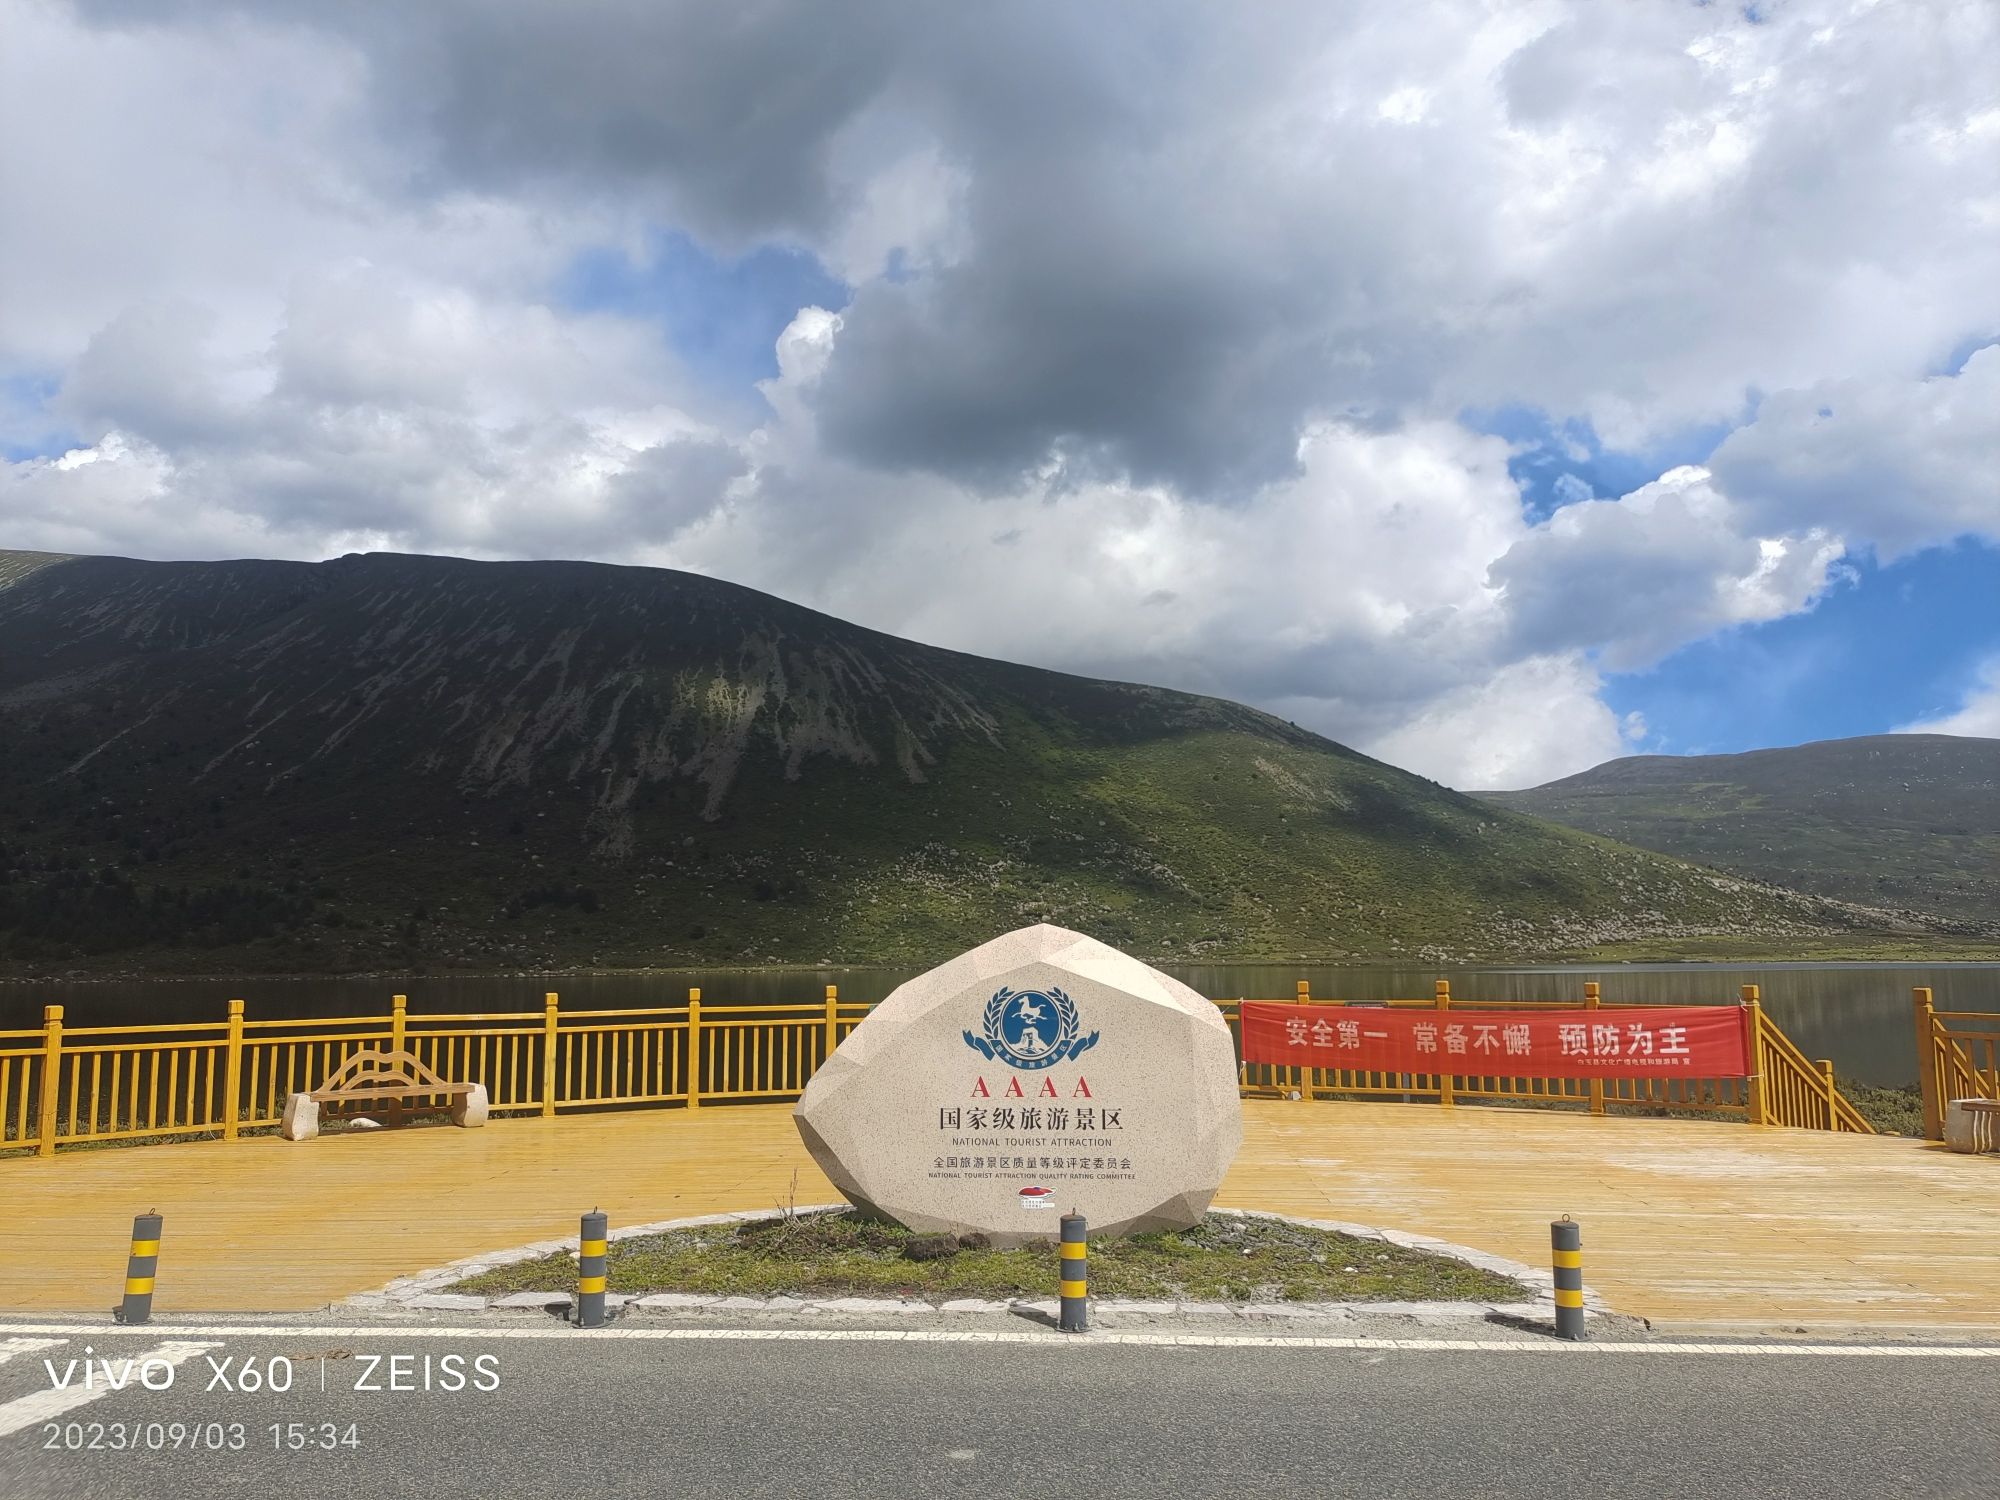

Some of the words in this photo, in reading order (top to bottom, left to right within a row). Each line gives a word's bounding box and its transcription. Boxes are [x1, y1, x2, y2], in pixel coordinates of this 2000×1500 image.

[1286, 1016, 1388, 1050] 安全第一
[1412, 1021, 1531, 1056] 常备不懈
[1558, 1021, 1690, 1056] 预防为主
[939, 1106, 1124, 1131] 国家级旅游景区
[952, 1137, 1000, 1147] NATIONAL
[1005, 1138, 1046, 1147] TOURIST
[1051, 1138, 1112, 1147] ATTRACTION
[933, 1156, 1132, 1170] 全国旅游景区质量等级评定委员会
